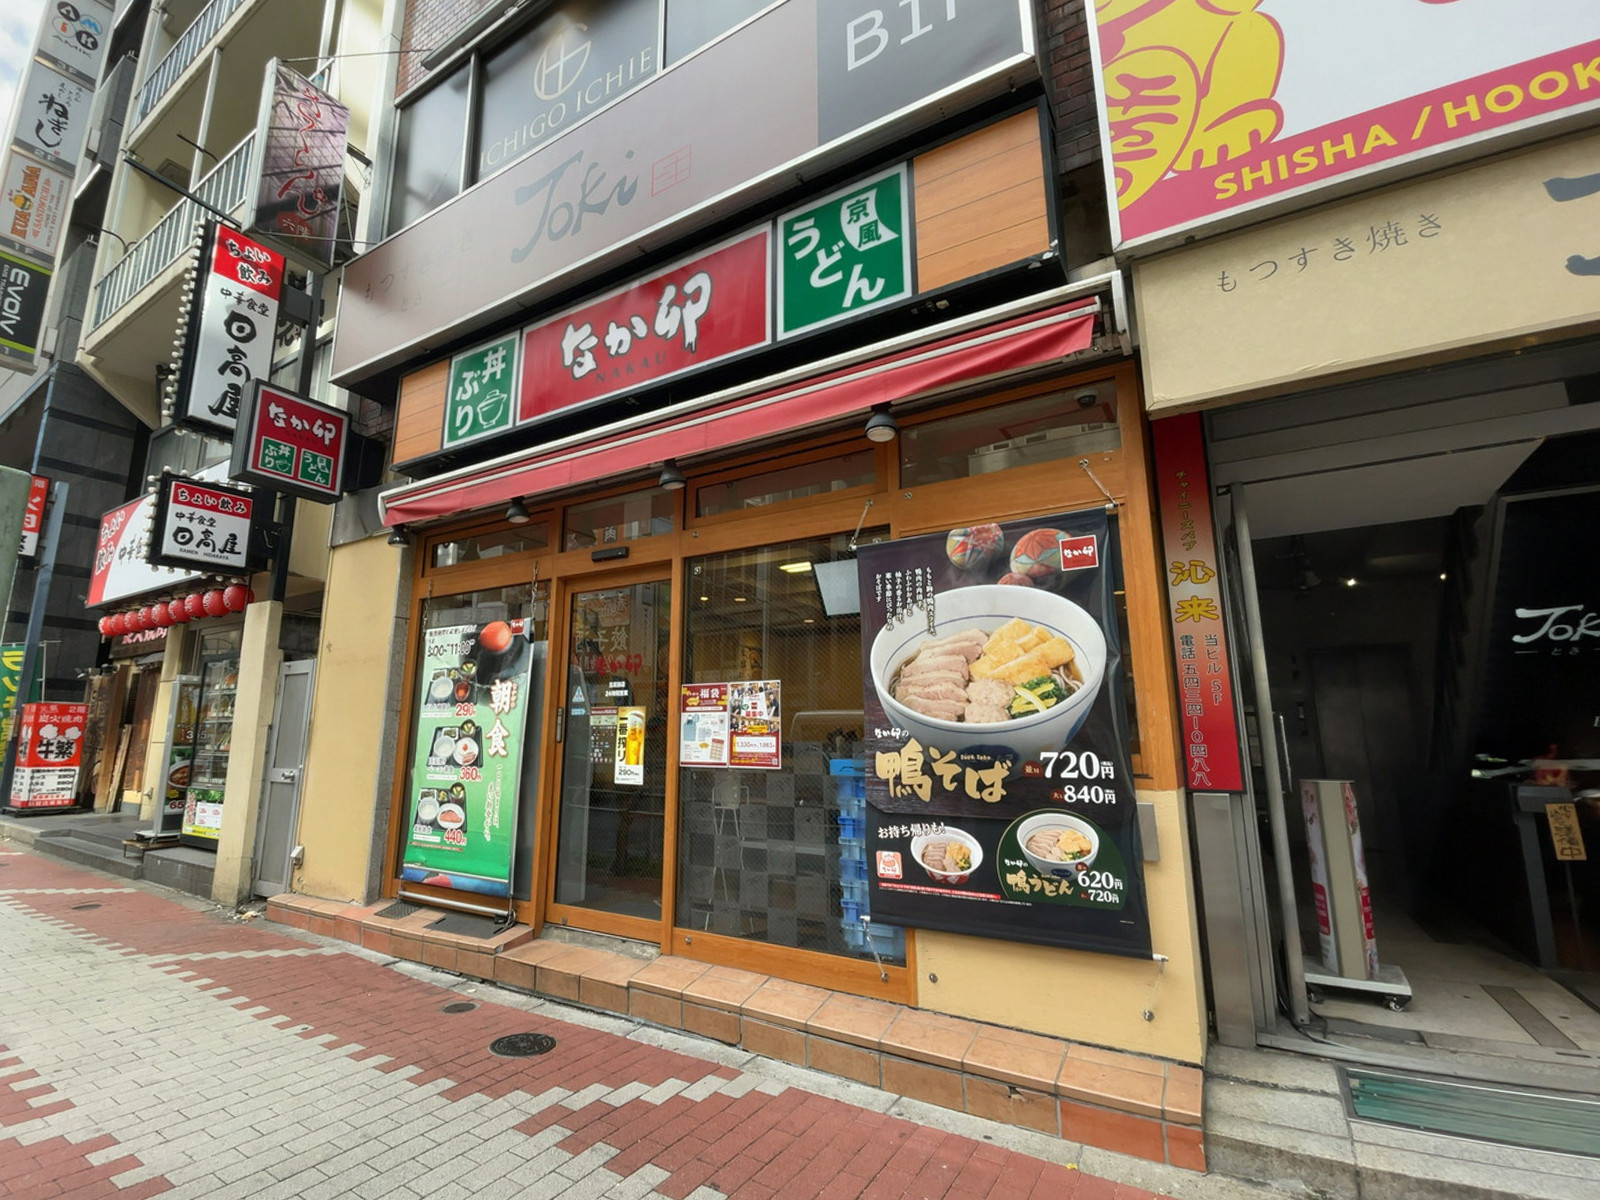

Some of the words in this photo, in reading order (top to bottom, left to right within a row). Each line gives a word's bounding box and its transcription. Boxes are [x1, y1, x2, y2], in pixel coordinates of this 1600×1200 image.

[38, 92, 69, 148] ねぎし
[480, 102, 566, 173] ICHIGO
[575, 46, 652, 113] ICHIE
[1214, 124, 1398, 200] SHISHA
[846, 196, 882, 248] 京風
[225, 239, 272, 263] ちょい
[787, 217, 886, 308] うどん
[1216, 212, 1444, 293] もつすき焼き
[236, 264, 273, 285] 飲み
[220, 286, 271, 319] 中華食堂
[560, 270, 712, 381] なか卯
[207, 310, 259, 421] 日高屋
[594, 351, 669, 383] NAKAU
[268, 401, 337, 448] なか卯
[303, 452, 327, 484] うどん
[178, 488, 247, 513] ちょい飲み
[1176, 471, 1197, 551] チャイニーズパブ
[175, 512, 217, 528] 中華食堂
[172, 526, 242, 555] 日高屋
[1063, 545, 1094, 559] なか卯
[700, 688, 720, 699] 福袋
[486, 679, 512, 758] 朝食
[37, 738, 75, 759] 牛繁
[875, 737, 1013, 804] 鴨そば
[1040, 751, 1115, 779] 720円
[1063, 784, 1117, 805] 840円
[1006, 869, 1075, 897] 鴨うどん
[1077, 870, 1124, 890] 620円
[1088, 889, 1120, 904] 720円
